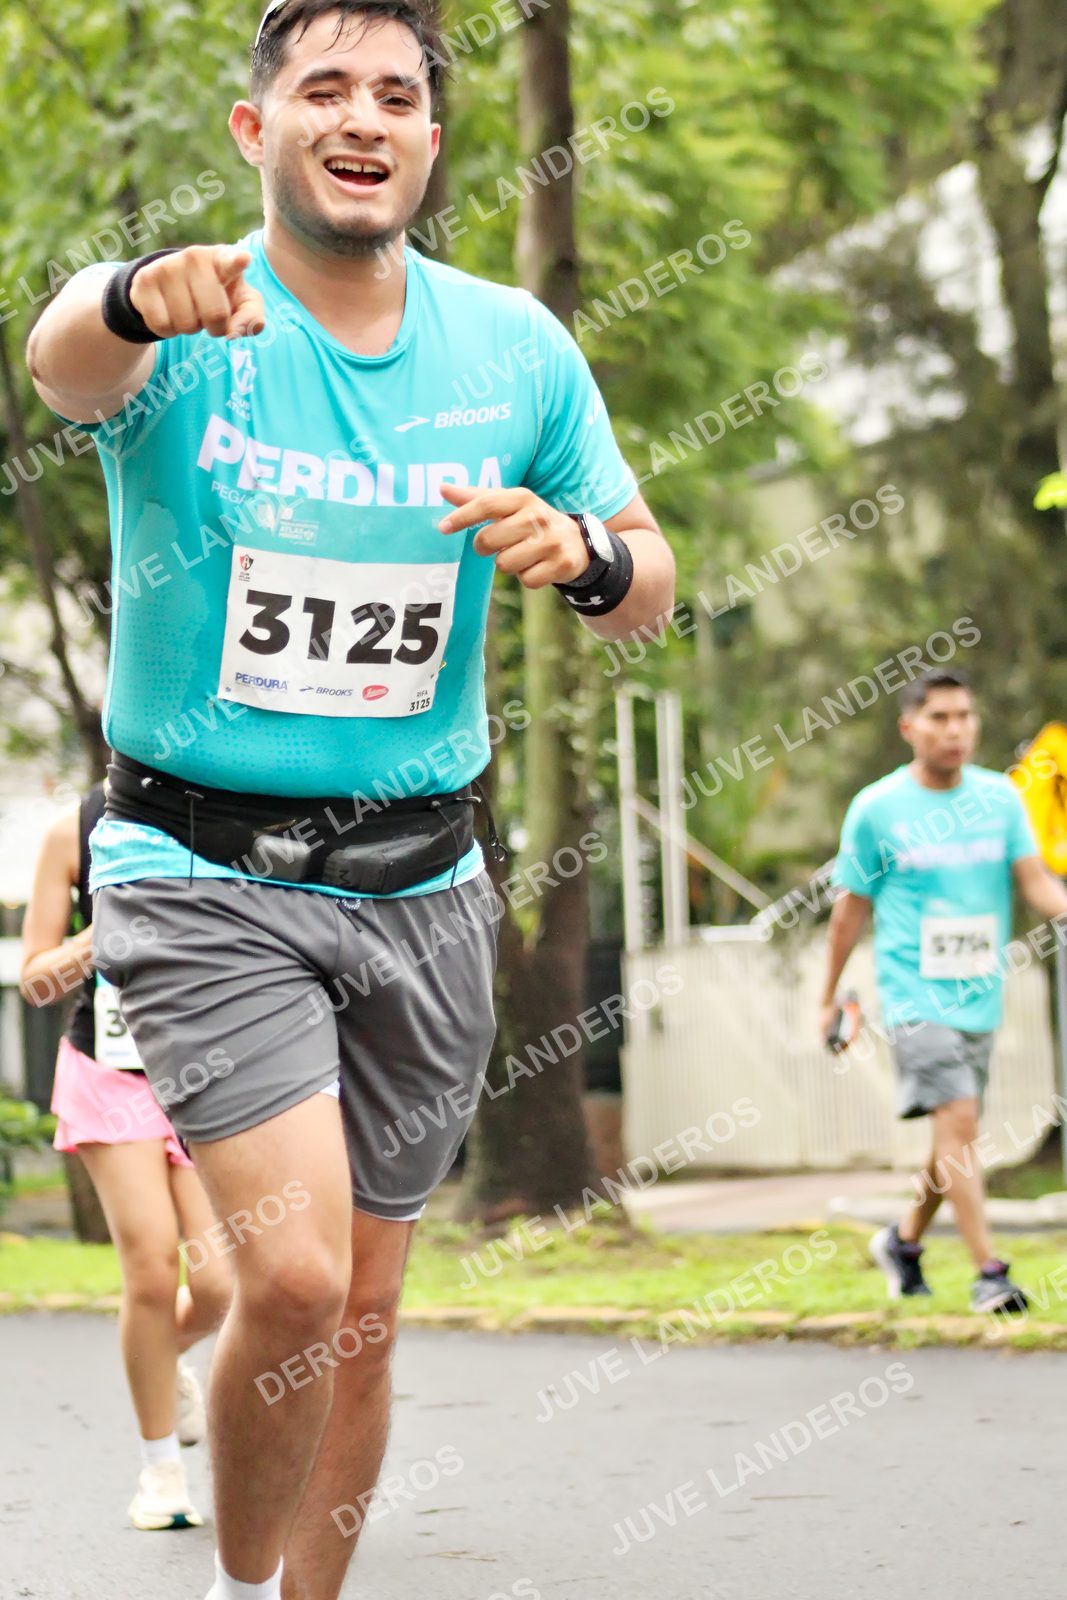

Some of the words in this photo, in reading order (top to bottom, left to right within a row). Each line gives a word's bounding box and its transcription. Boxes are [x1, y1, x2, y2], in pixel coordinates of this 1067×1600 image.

[434, 401, 513, 429] BROOKS
[239, 589, 443, 665] 3125
[235, 672, 288, 690] PERDURA
[316, 686, 353, 697] BROOKS
[409, 697, 431, 712] 3125
